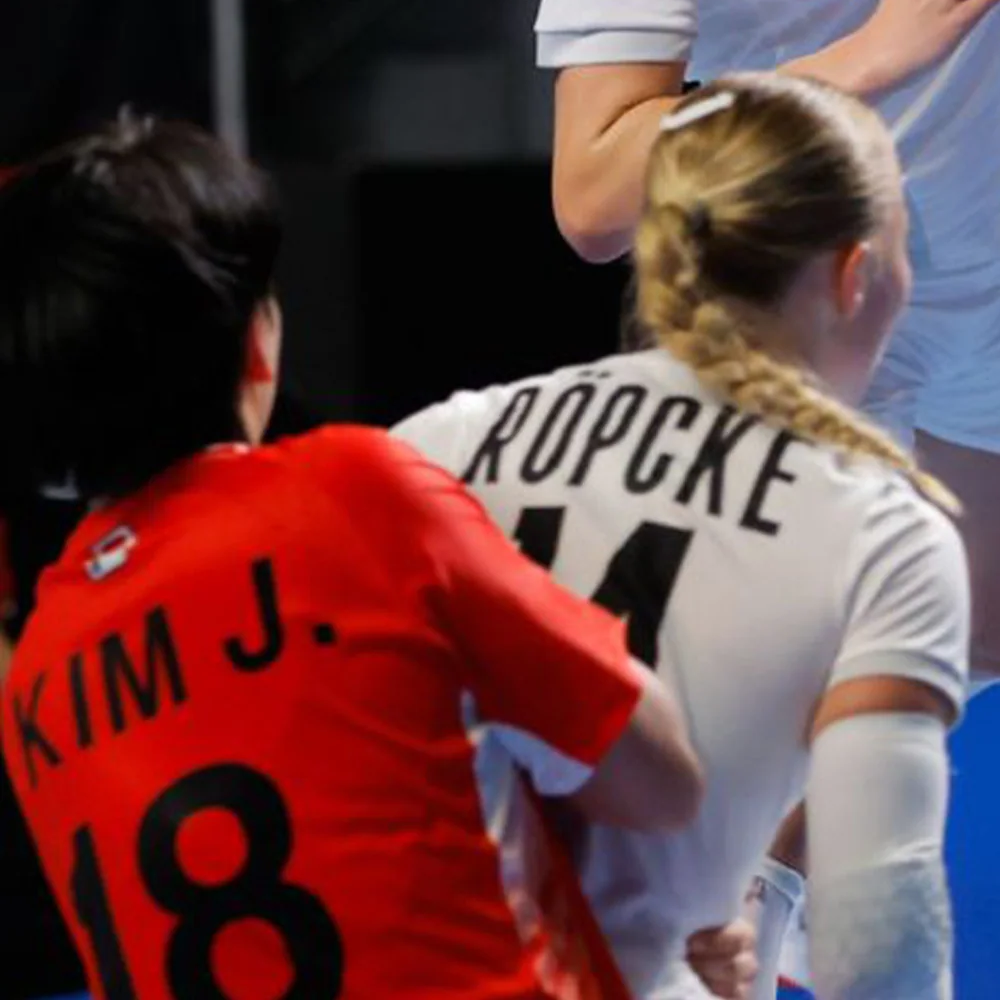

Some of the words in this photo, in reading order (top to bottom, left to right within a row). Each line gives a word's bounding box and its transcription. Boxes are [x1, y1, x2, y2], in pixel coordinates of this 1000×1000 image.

[461, 369, 810, 537] RÖPCKE
[14, 605, 188, 790] KIM
[223, 557, 337, 672] J.
[70, 761, 346, 1000] 18
